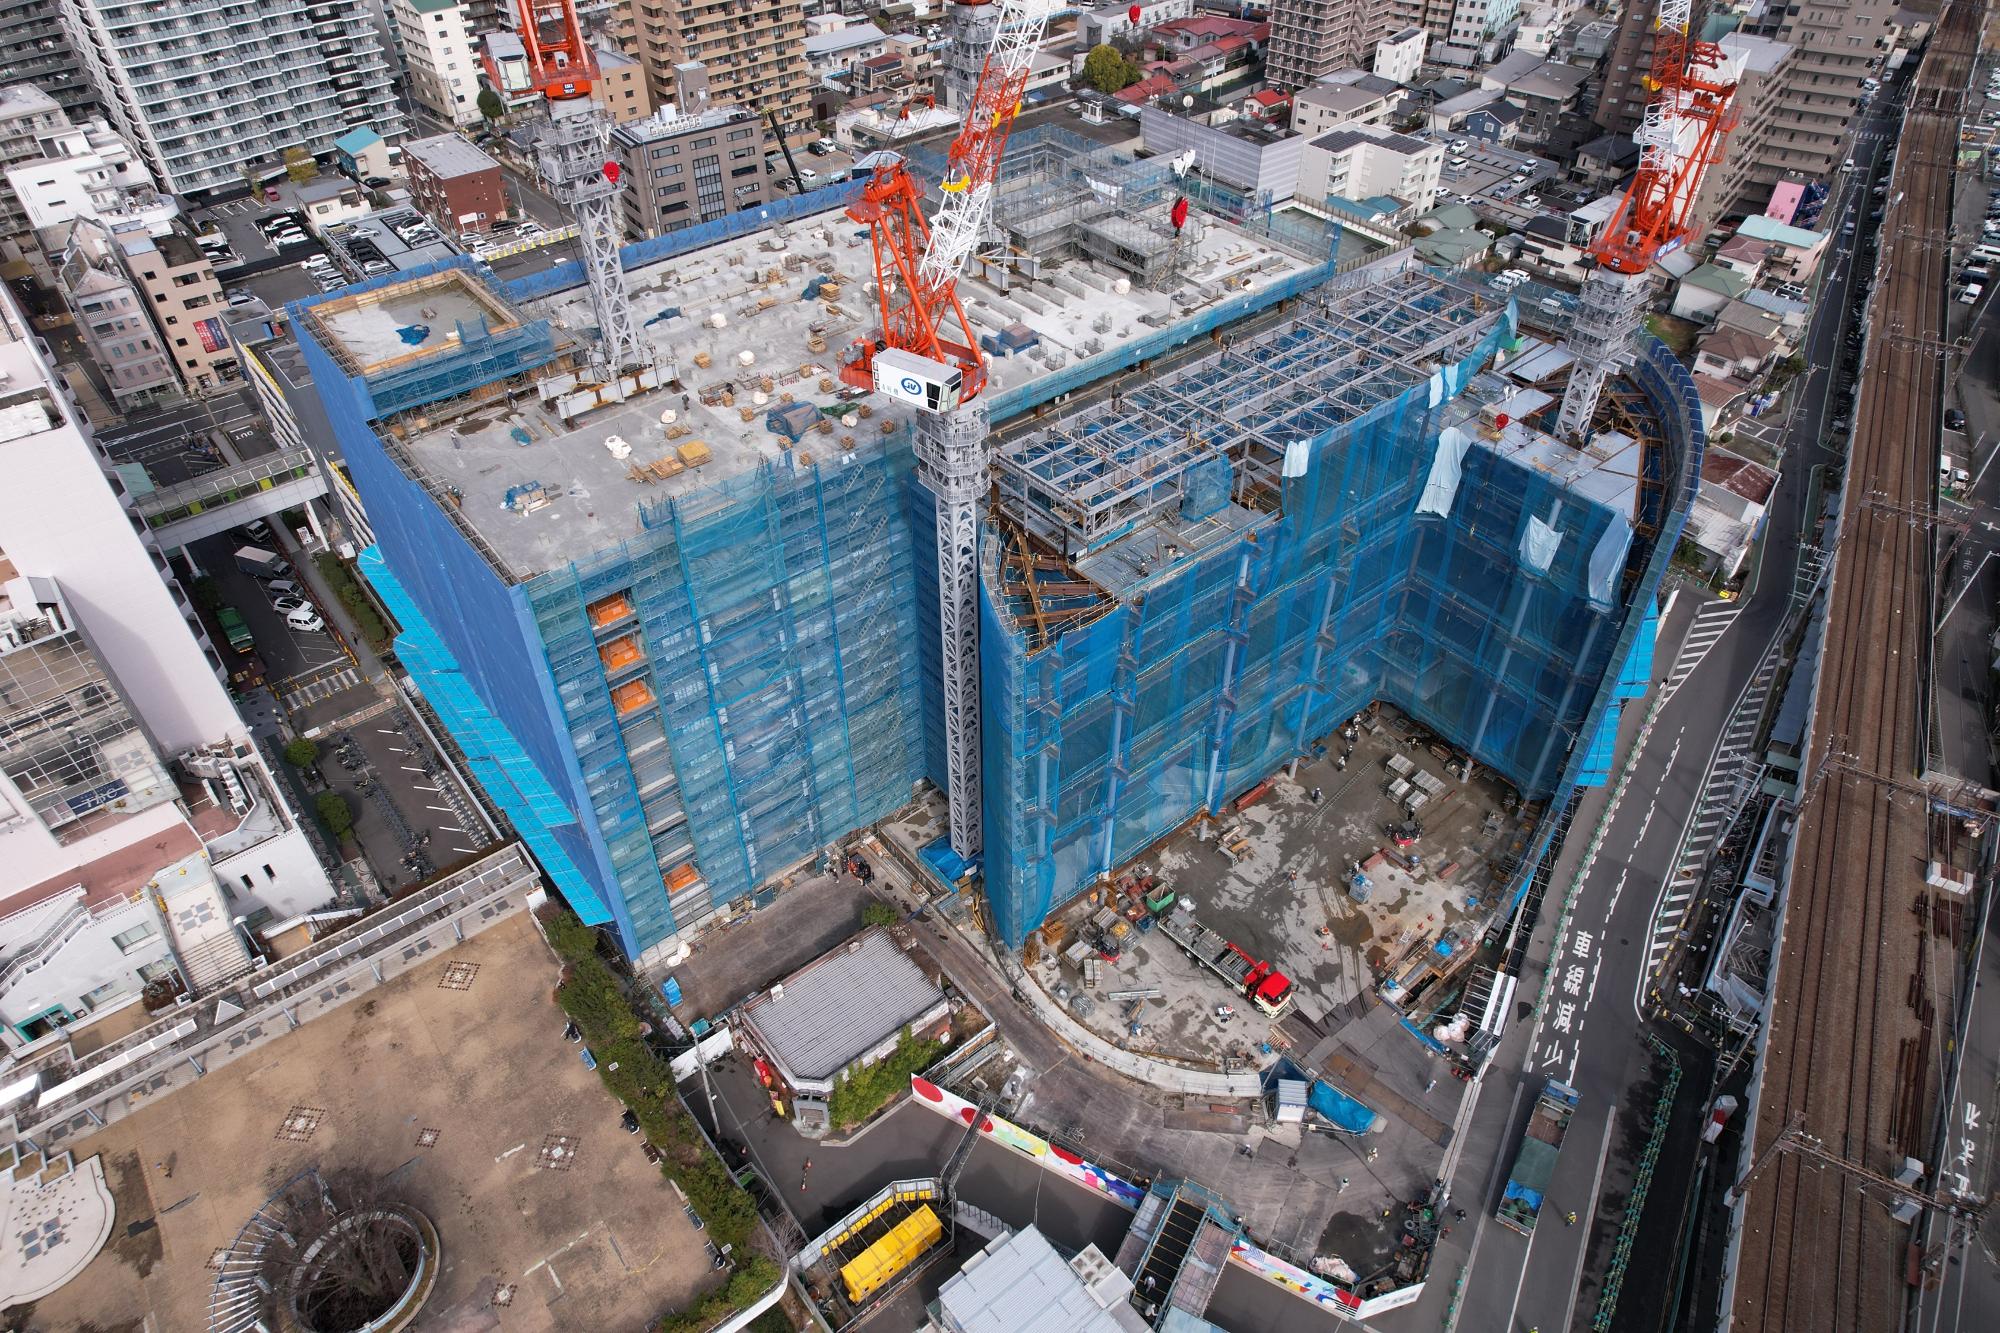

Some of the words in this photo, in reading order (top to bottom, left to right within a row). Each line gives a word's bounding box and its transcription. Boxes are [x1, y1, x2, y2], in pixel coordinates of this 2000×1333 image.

[236, 431, 254, 440] OUT
[1542, 930, 1593, 1068] 車線減少
